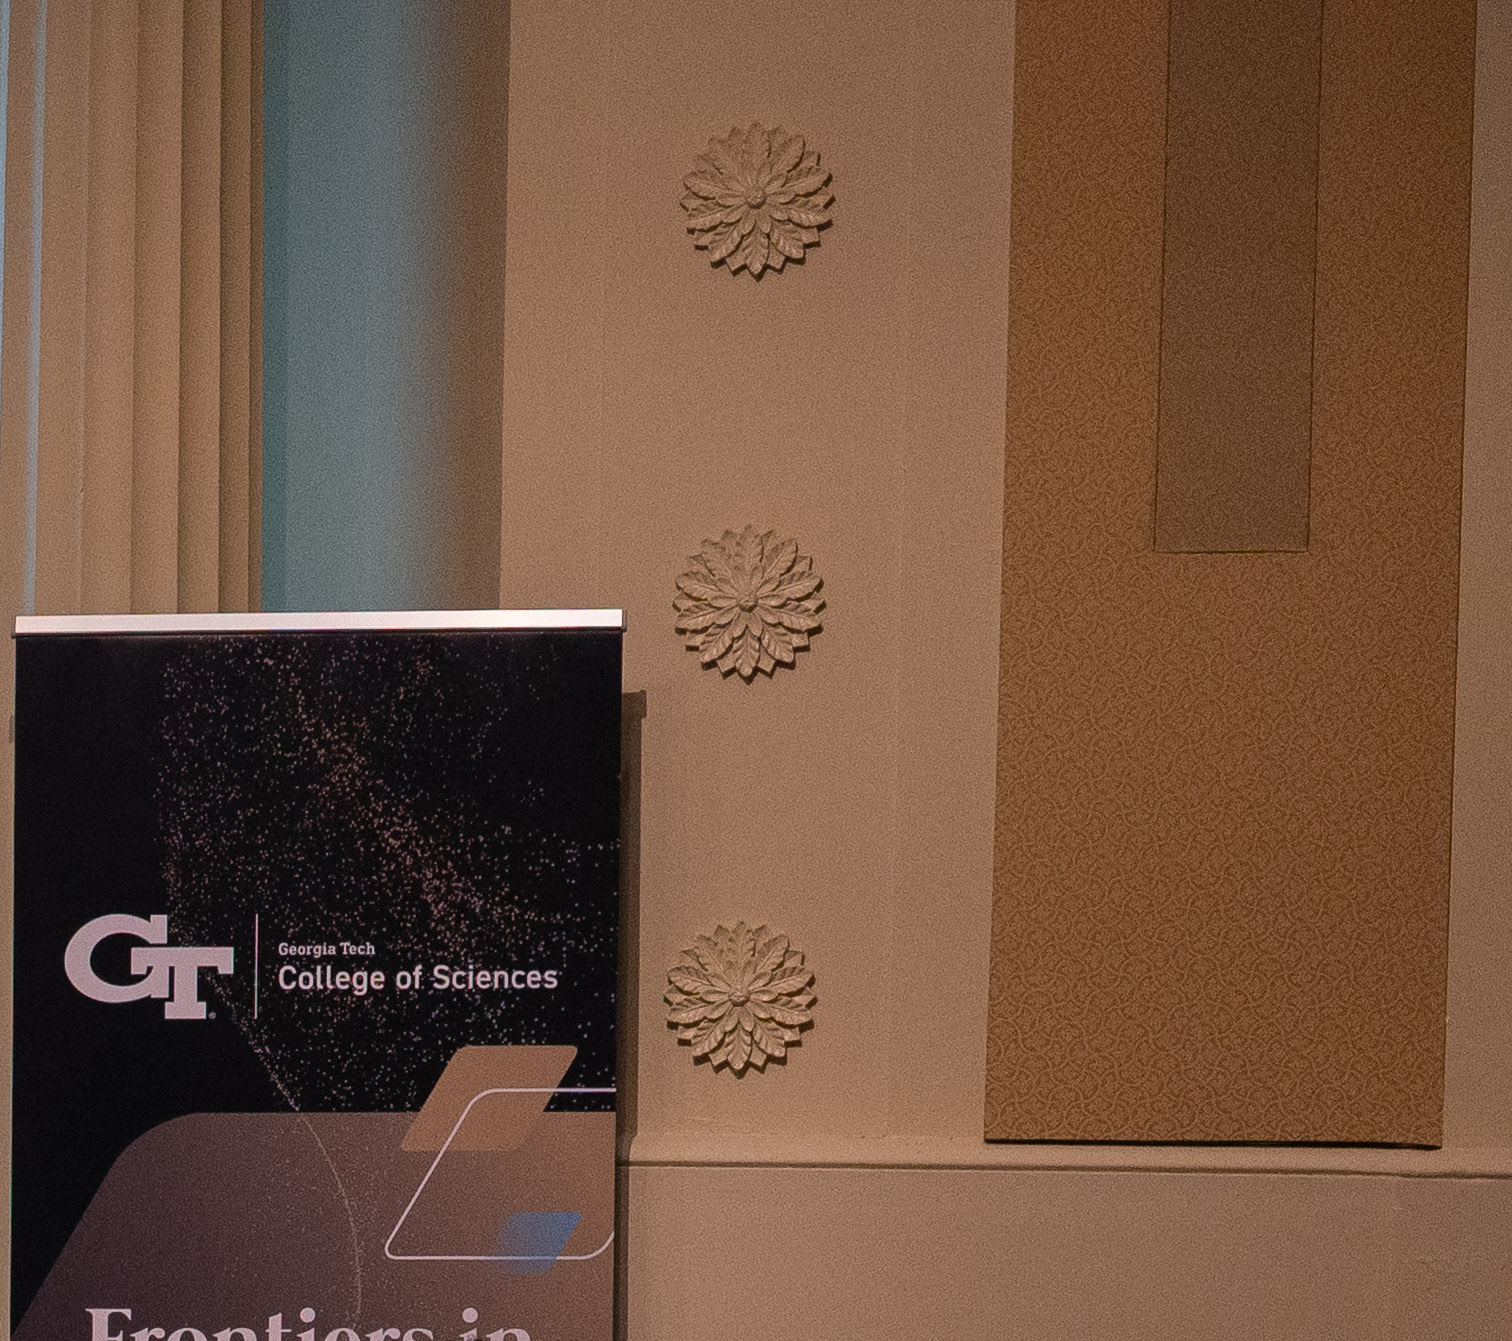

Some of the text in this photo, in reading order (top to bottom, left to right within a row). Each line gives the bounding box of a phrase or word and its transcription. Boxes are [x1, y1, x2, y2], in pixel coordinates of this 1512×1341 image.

[64, 913, 235, 1020] GT
[277, 942, 376, 960] Georgia Tech
[277, 964, 559, 995] College of Sciences
